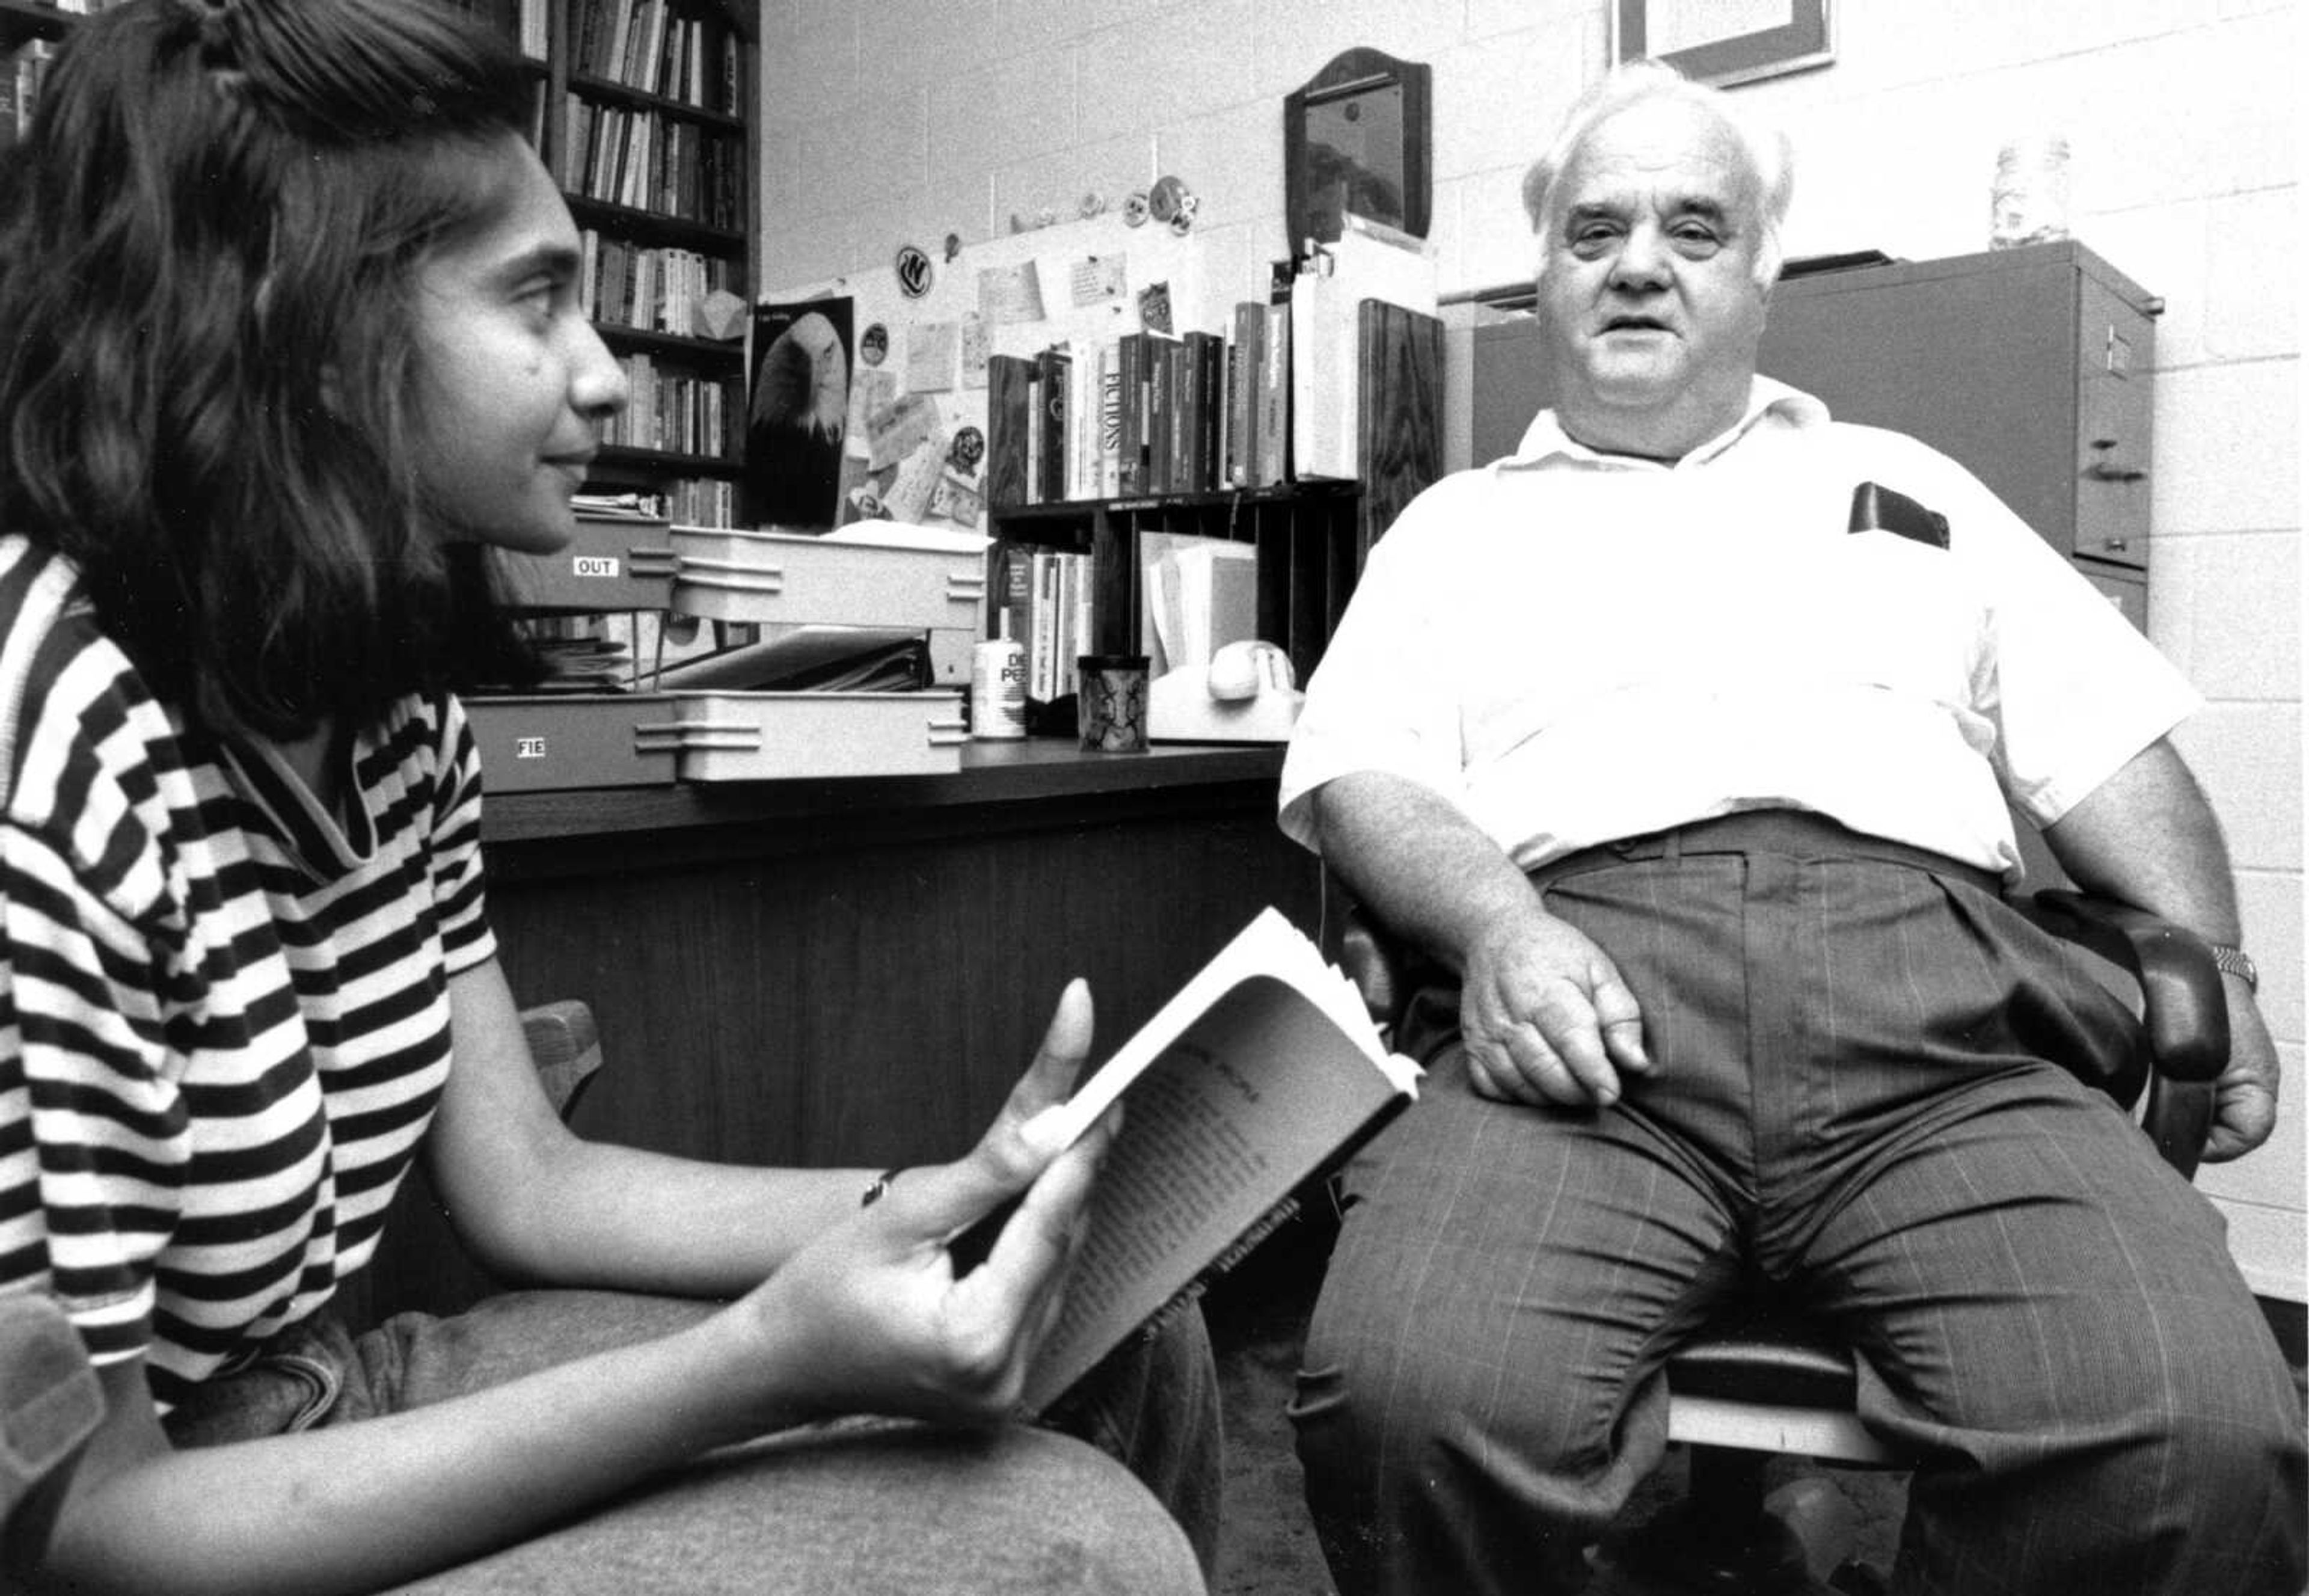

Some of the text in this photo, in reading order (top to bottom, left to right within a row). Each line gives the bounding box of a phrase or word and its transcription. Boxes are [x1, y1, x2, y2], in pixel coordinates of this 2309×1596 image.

[1105, 373, 1120, 450] FICTIONS
[578, 560, 611, 574] OUT
[519, 740, 545, 754] FIE
